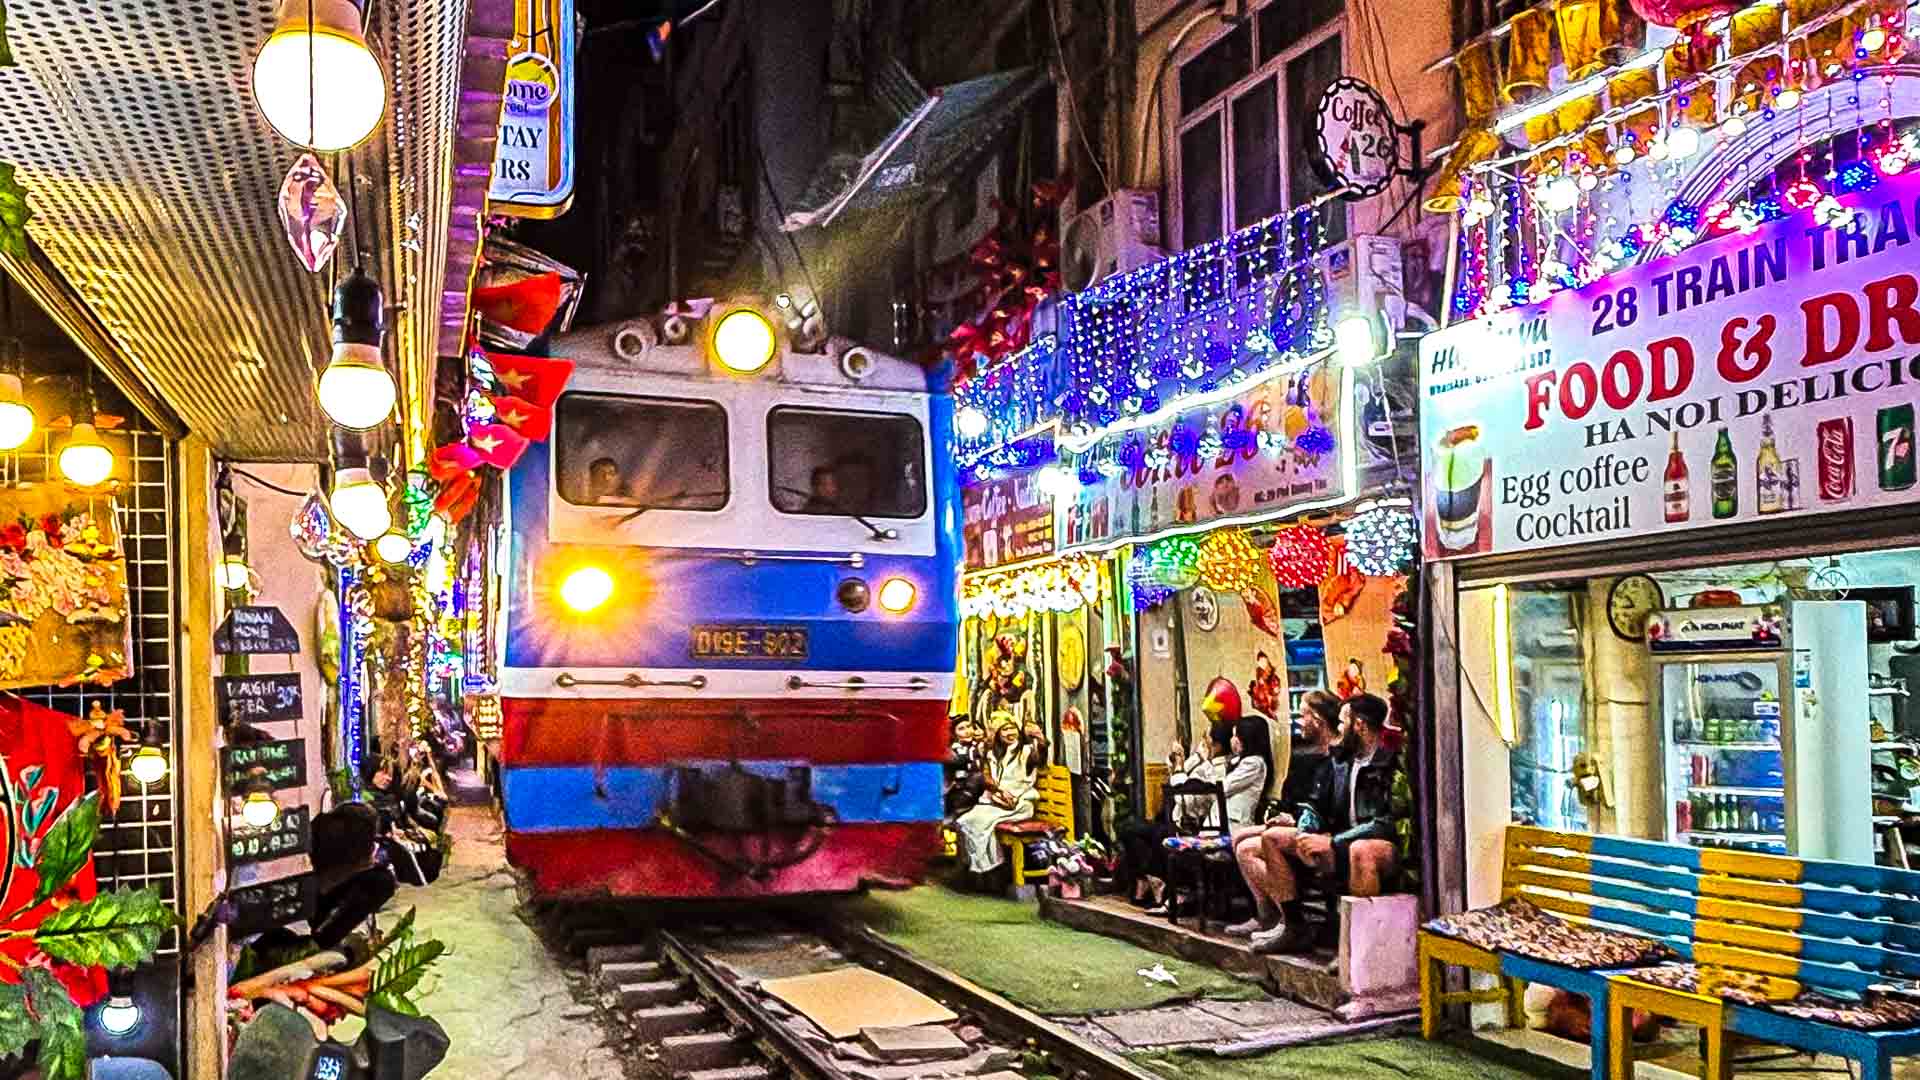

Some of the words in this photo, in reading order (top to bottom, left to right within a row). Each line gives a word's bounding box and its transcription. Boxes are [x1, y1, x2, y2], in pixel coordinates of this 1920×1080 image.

[1332, 96, 1383, 132] Coffee
[495, 158, 531, 181] RS
[1361, 133, 1391, 159] 26
[1592, 287, 1638, 337] 28
[1651, 238, 1787, 317] TRAIN
[1804, 197, 1920, 272] TRA
[1524, 336, 1696, 431] FOOD
[1716, 314, 1777, 383] &
[1583, 417, 1636, 448] HA
[1645, 396, 1723, 436] NOI
[1502, 470, 1551, 508] Egg
[1560, 453, 1650, 494] coffee
[1515, 495, 1632, 542] Cocktail
